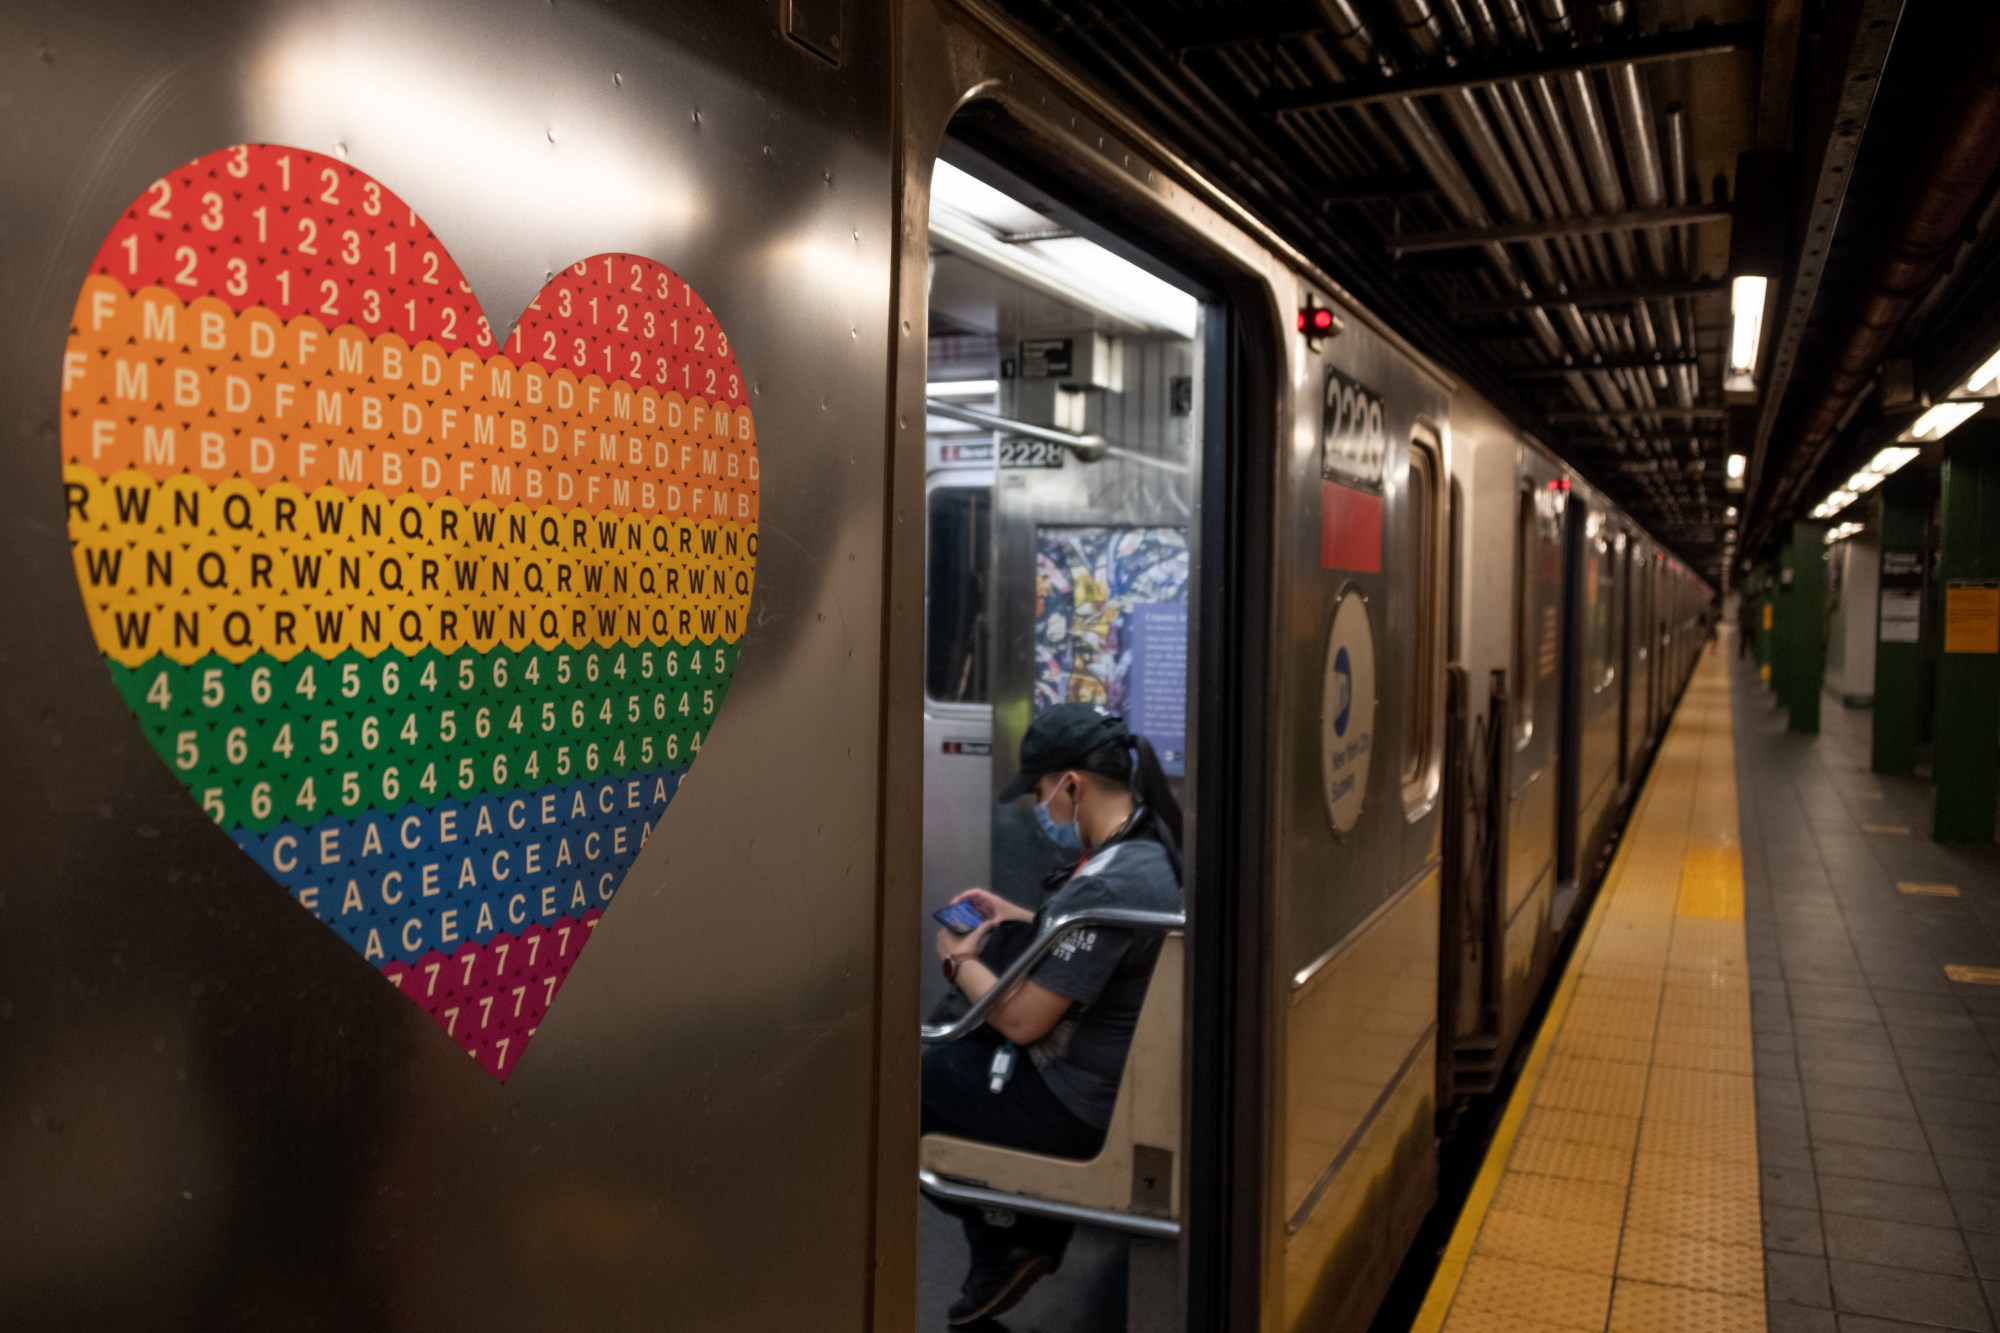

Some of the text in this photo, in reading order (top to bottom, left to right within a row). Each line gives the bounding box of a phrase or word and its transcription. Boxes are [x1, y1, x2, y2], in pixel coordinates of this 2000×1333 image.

[227, 144, 380, 216] 3 1 2 3
[148, 179, 317, 255] 2 3 1 2
[604, 258, 690, 306] 1 2 3 1
[122, 235, 738, 399] 1 2 3 1 2 3 1 2 3 1 2 3 1 2 3 1 2 3
[558, 289, 655, 338] 3 1 2 3
[63, 352, 251, 413] F M B D
[93, 292, 750, 440] F M B D F M B D F M B D F M B D F M B
[92, 420, 275, 473] F M B D
[65, 484, 737, 555] R W N Q R W N Q R W N Q R W N Q R W N
[87, 549, 272, 588] W N Q R
[115, 611, 296, 647] W N Q R
[146, 649, 725, 710] 4 5 6 4 5 6 4 5 6 4 5 6 4 5 6 4 5
[176, 719, 339, 770] 5 6 4 5
[203, 771, 360, 824] 5 6 4 5
[272, 777, 667, 873] C E A C E A C E A C E A
[341, 863, 440, 915] A C E
[364, 909, 459, 960] A C E
[424, 927, 570, 997] 7 7 7 7 7
[444, 976, 556, 1037] 7 7 7 7
[496, 1037, 510, 1070] 7
